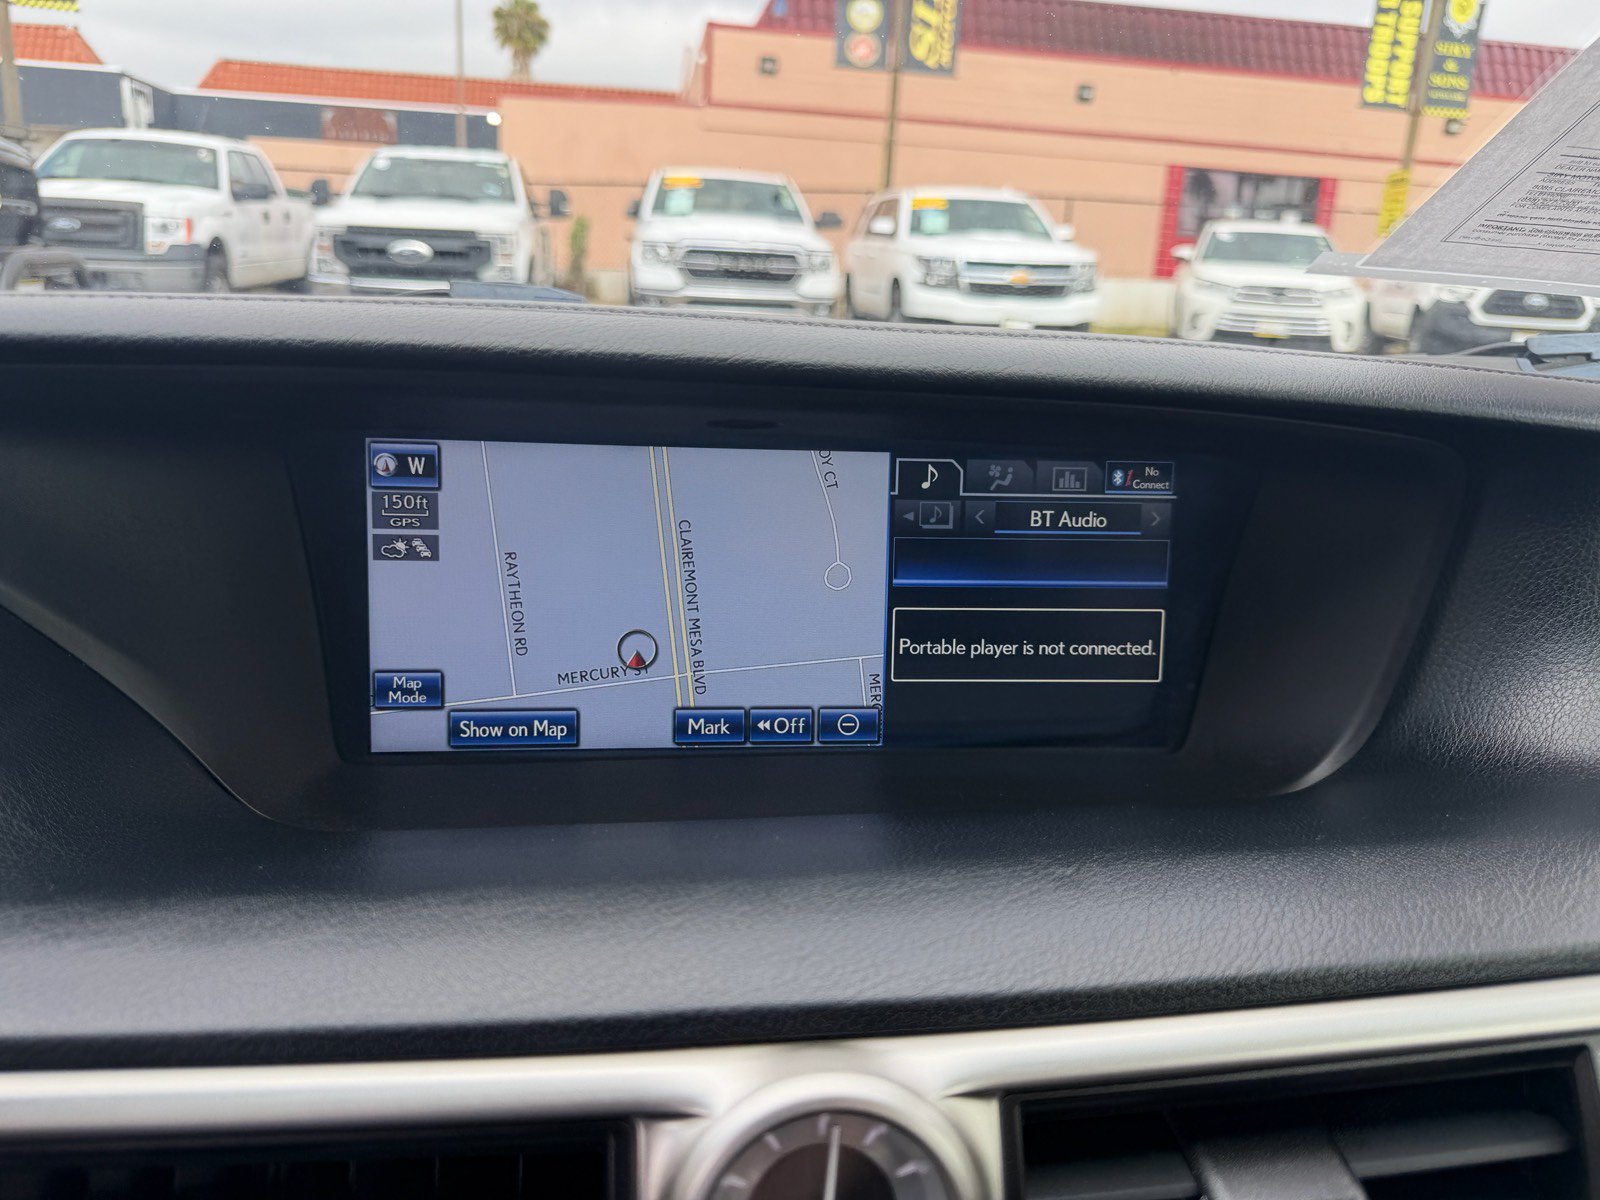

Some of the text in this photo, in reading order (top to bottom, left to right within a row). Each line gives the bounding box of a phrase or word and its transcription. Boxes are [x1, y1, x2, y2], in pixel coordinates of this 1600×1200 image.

[407, 456, 426, 475] W
[1145, 466, 1159, 477] No
[824, 471, 839, 489] CT
[1133, 480, 1169, 490] Connect
[382, 495, 428, 510] 150ft
[390, 518, 420, 527] GPS
[1030, 510, 1107, 528] BT Audio
[504, 551, 528, 656] RAYTHEON RD
[678, 519, 707, 695] CLAIREMONT MESA BLVD
[899, 638, 1156, 659] Portable player is not connected.
[557, 665, 628, 685] MERCURY
[393, 677, 422, 691] Map
[388, 691, 427, 703] Mode
[459, 720, 567, 740] Show on Map
[688, 718, 730, 735] Mark
[774, 717, 806, 734] Off
